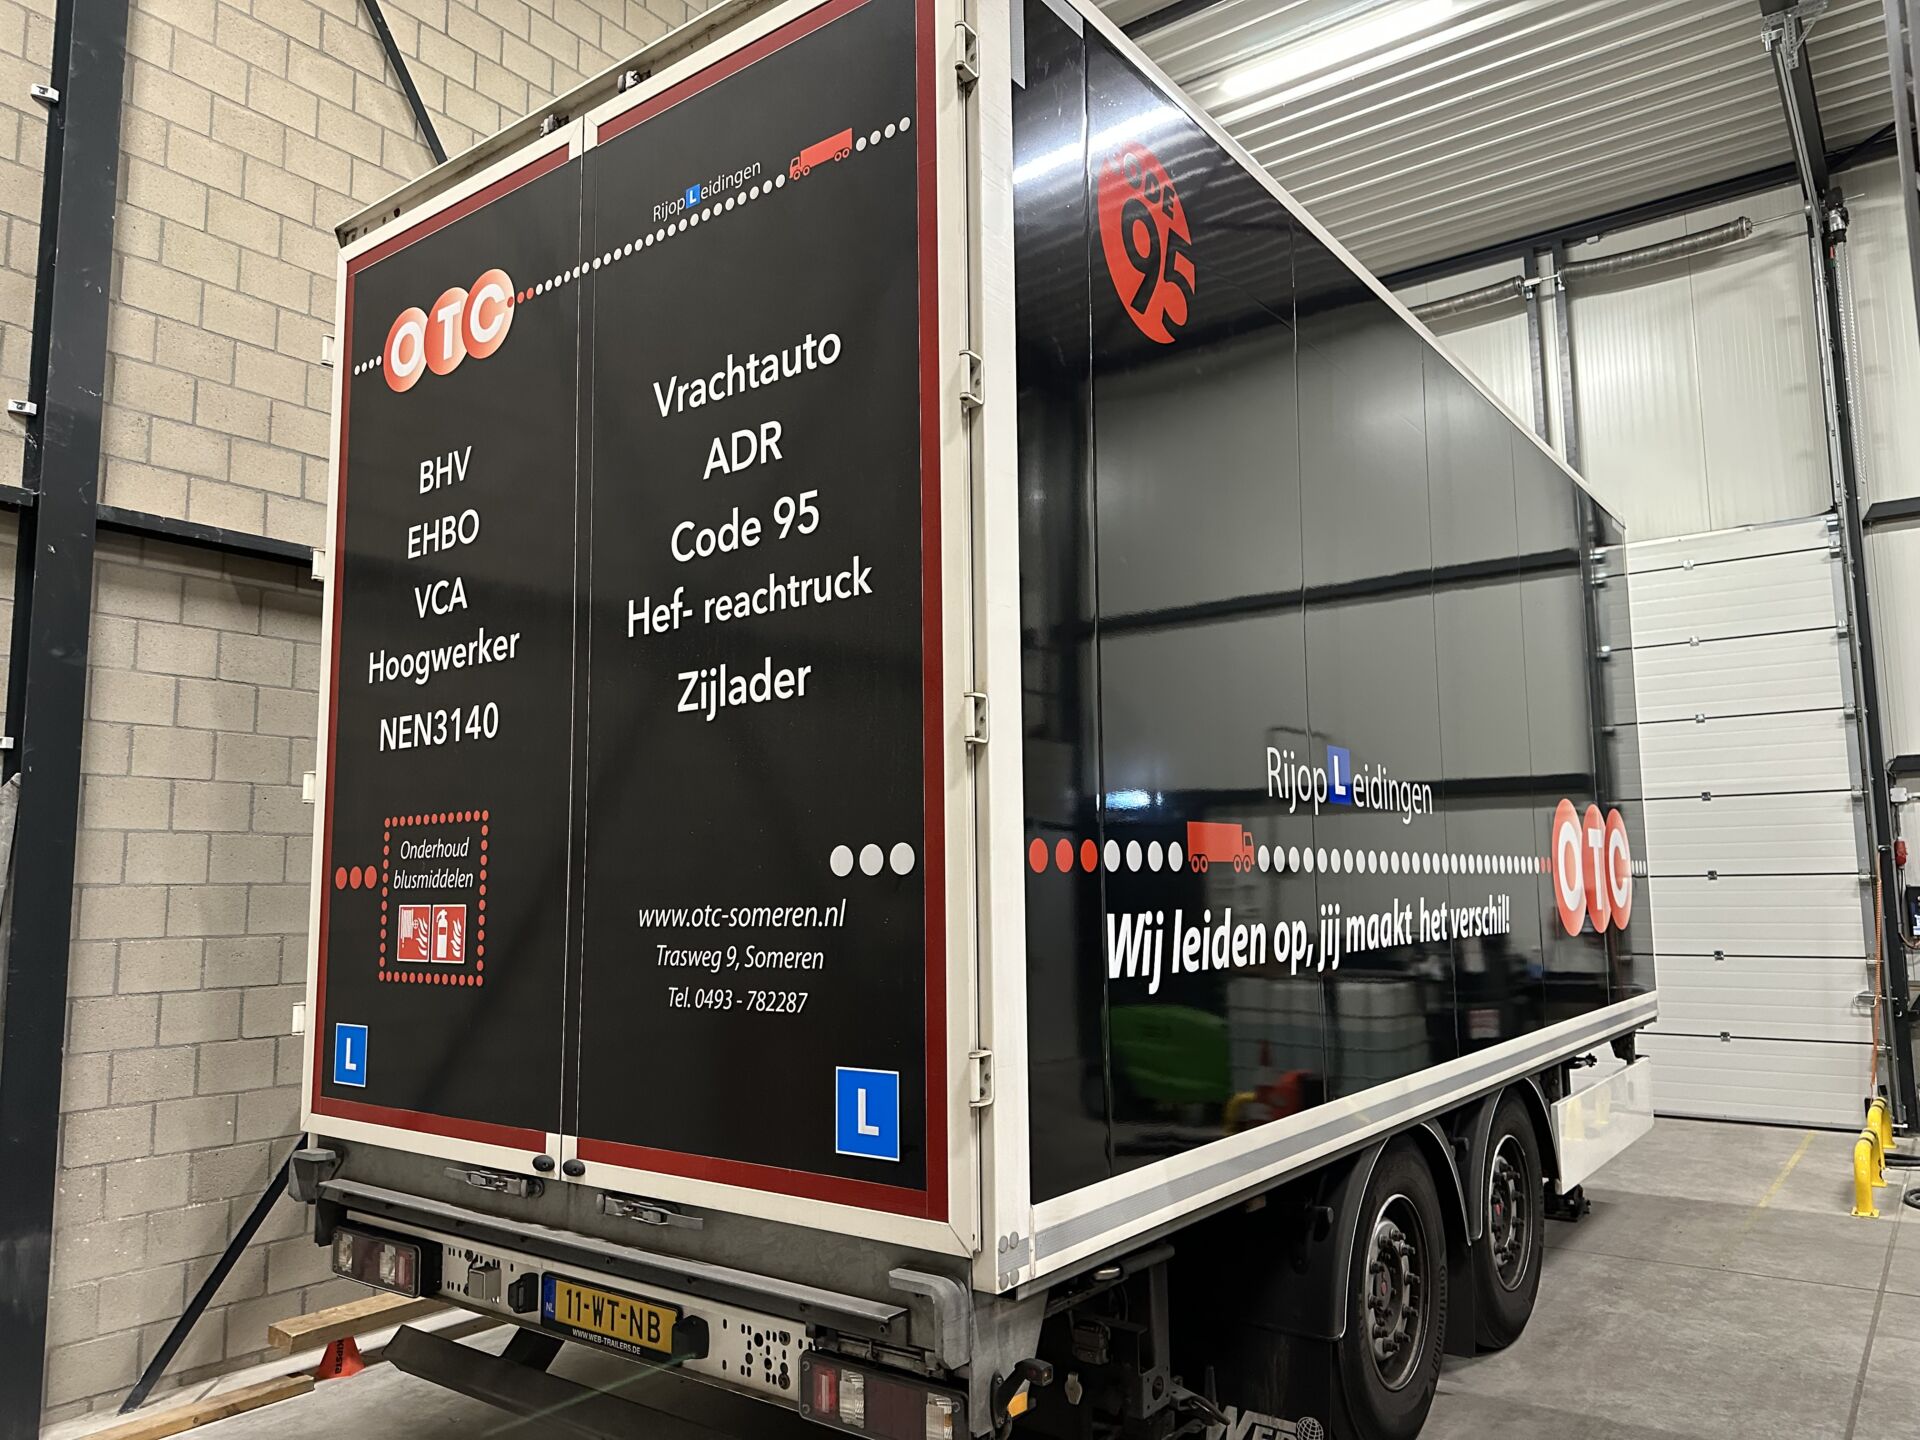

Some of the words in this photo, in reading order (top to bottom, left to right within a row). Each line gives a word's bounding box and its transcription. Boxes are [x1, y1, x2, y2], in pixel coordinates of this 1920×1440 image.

[1121, 197, 1198, 340] 95
[388, 281, 506, 378] OTC
[652, 331, 842, 418] Vrachtauto
[418, 446, 473, 495] BHV
[702, 420, 783, 480] ADR
[407, 508, 481, 559] EHBO
[670, 507, 762, 563] Code
[772, 489, 821, 541] 95
[414, 577, 468, 619] VCA
[626, 573, 693, 638] Hef-
[703, 556, 873, 624] reachtruck
[367, 629, 521, 686] Hoogwerker
[676, 656, 812, 722] Zijlader
[378, 702, 500, 753] NEN3140
[400, 836, 470, 860] Onderhoud
[1557, 820, 1629, 912] OTC
[393, 867, 474, 889] blusmiddelen
[638, 898, 847, 927] www.otc-someren.nl
[656, 944, 722, 973] Trasweg
[726, 945, 740, 971] 9,
[744, 944, 824, 969] Someren
[1106, 910, 1164, 994] Wij
[1171, 907, 1266, 974] leiden
[1273, 919, 1314, 976] op,
[1317, 903, 1340, 973] jij
[1346, 898, 1413, 953] maakt
[1419, 897, 1448, 943] het
[1450, 894, 1510, 939] verschil!
[668, 986, 691, 1008] Tel.
[694, 988, 733, 1010] 0493
[746, 989, 808, 1013] 782287
[344, 1036, 358, 1073] L
[857, 1087, 880, 1137] L
[545, 1301, 554, 1313] NL
[565, 1288, 661, 1344] 11-WT-NB
[572, 1327, 641, 1355] WWW.WEB-TRAILERS.DE
